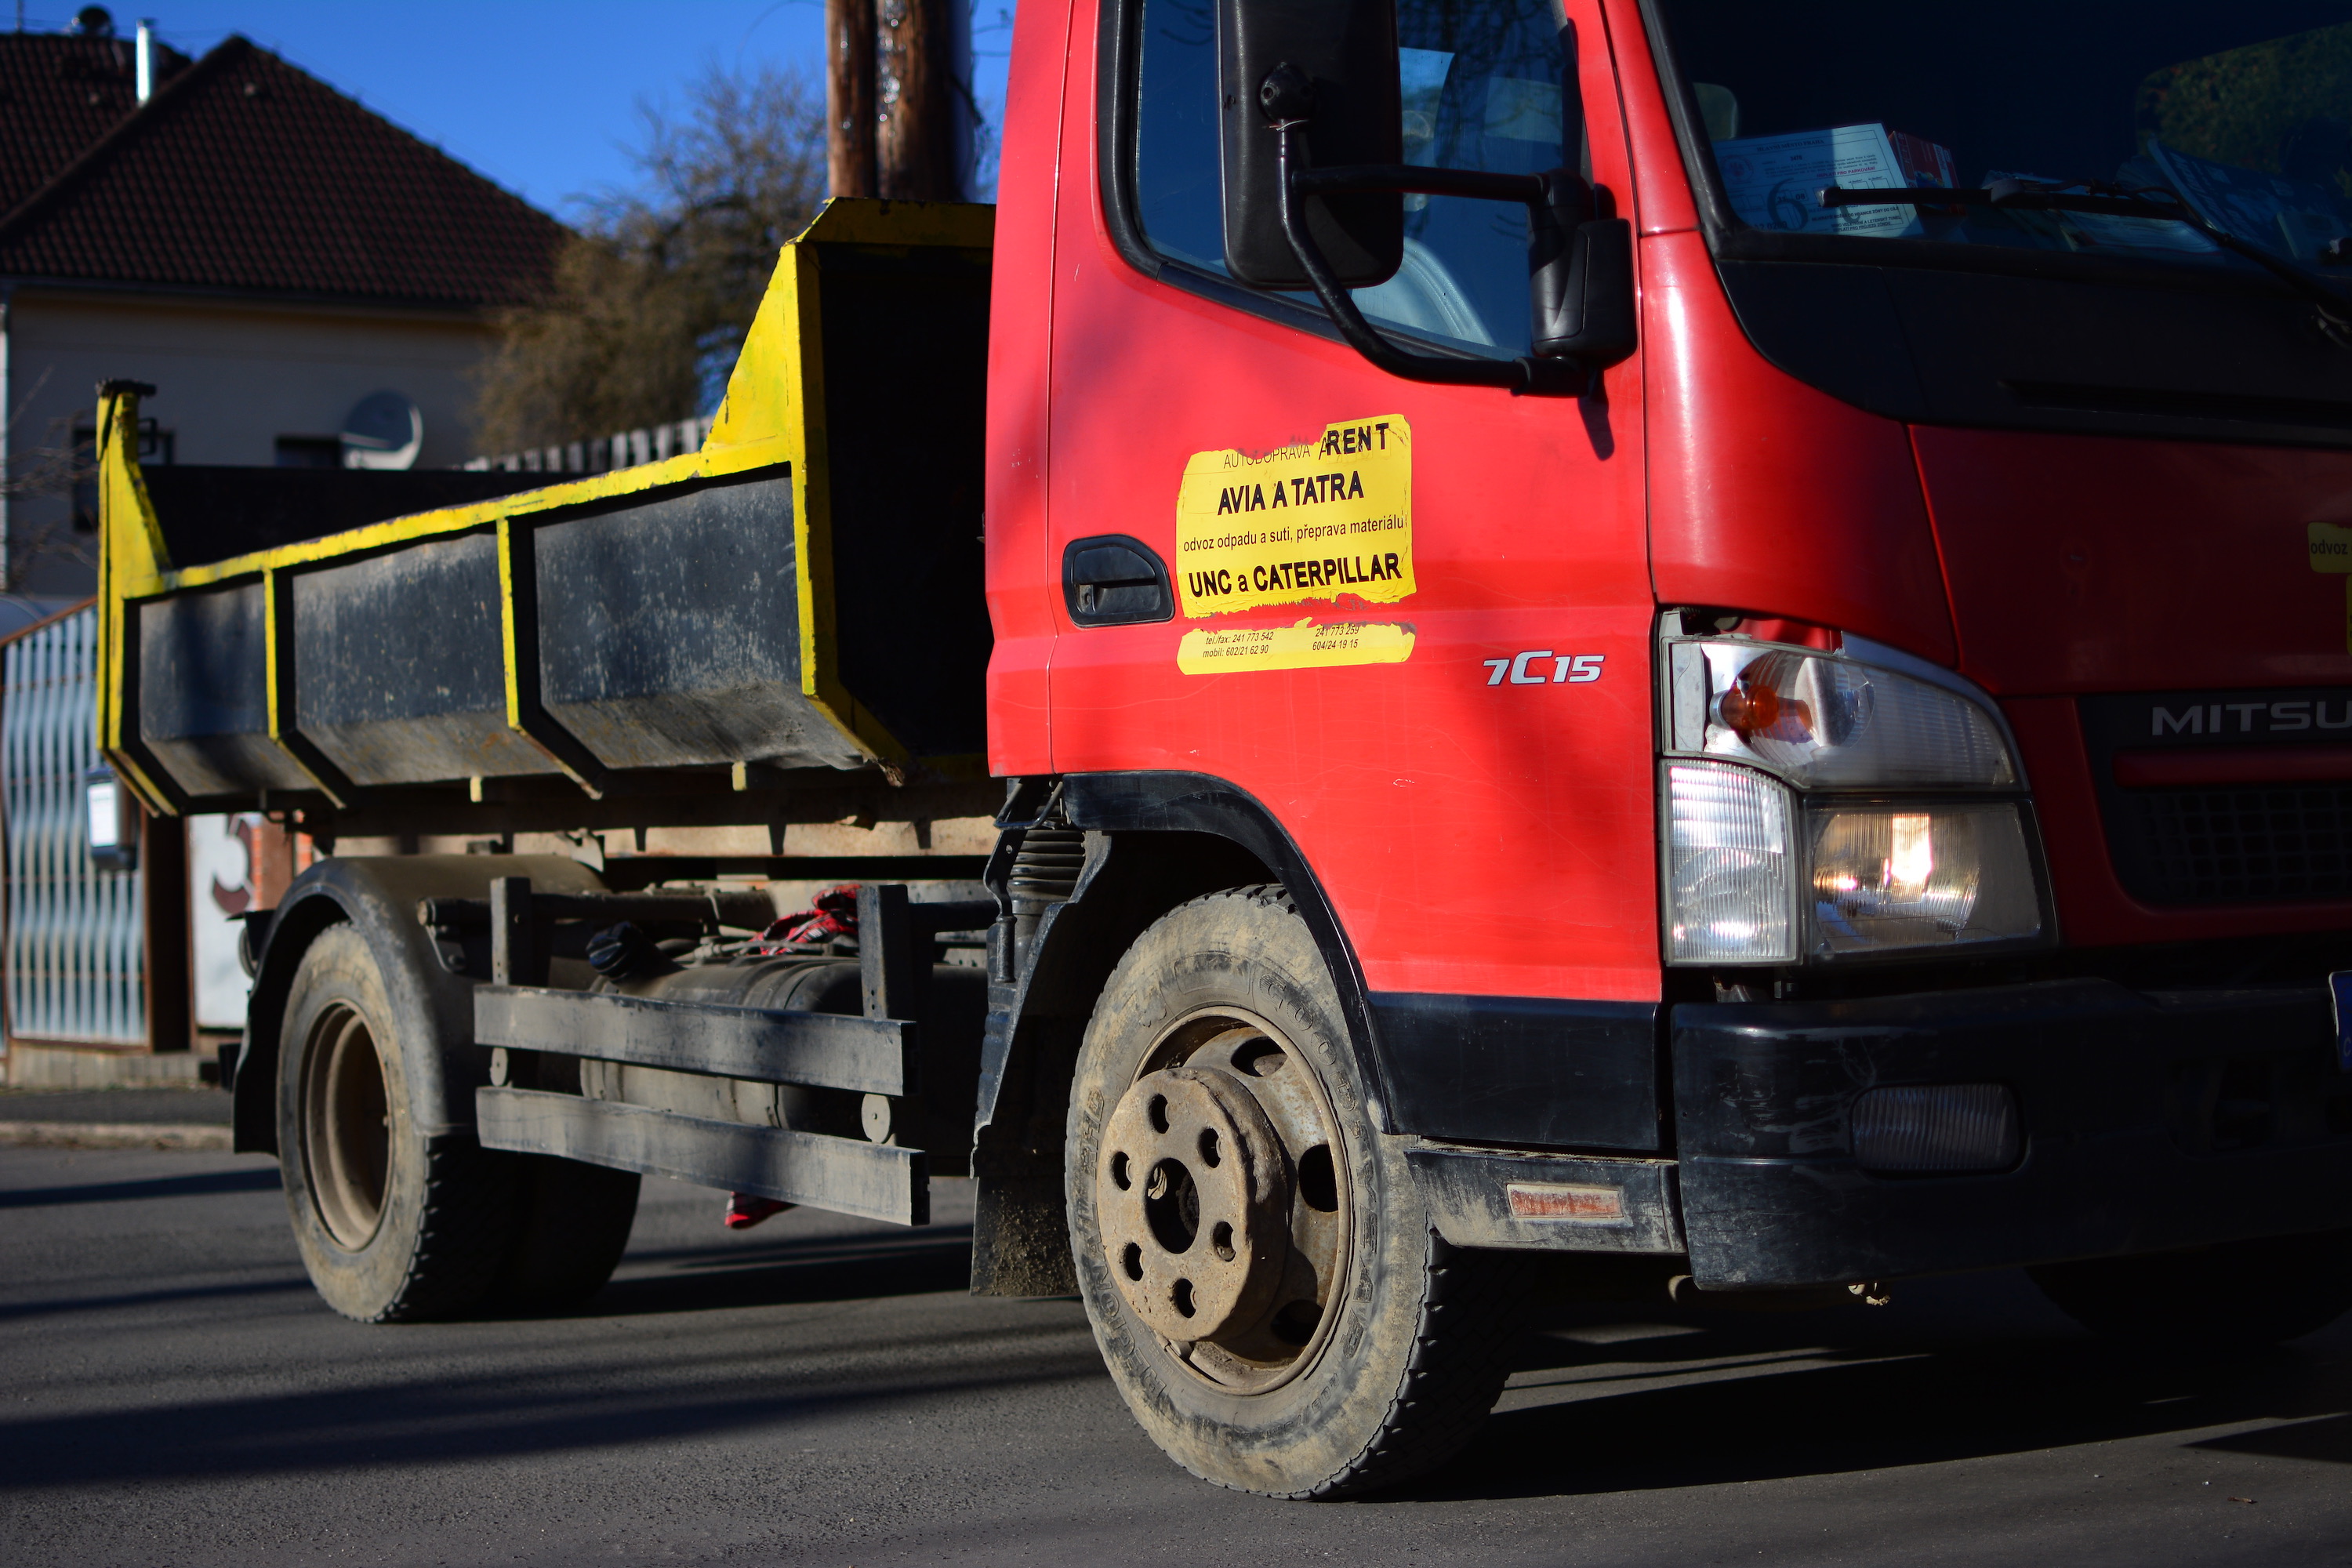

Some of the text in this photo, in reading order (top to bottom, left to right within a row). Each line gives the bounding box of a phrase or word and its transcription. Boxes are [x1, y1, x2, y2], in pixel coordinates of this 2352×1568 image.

[1768, 177, 1809, 230] 6
[1218, 470, 1364, 515] AVIA A TATRA
[1183, 514, 1404, 551] odvoz odpadu a suti, přeprava materiálu
[2310, 539, 2349, 555] odvoz
[1189, 552, 1403, 597] UNC a CATERPILLAR
[1206, 631, 1274, 644] tel./fax: 241 773 542
[1312, 638, 1359, 651] 604/24 19 15
[1316, 627, 1328, 637] 241
[1330, 626, 1344, 637] 773
[1203, 644, 1269, 658] mobil: 602/21 62 90
[1483, 649, 1606, 686] 7C15
[2151, 700, 2352, 736] MITSU
[1258, 971, 1378, 1359] GOODYEAR
[1078, 1200, 1167, 1399] REGIONAL
